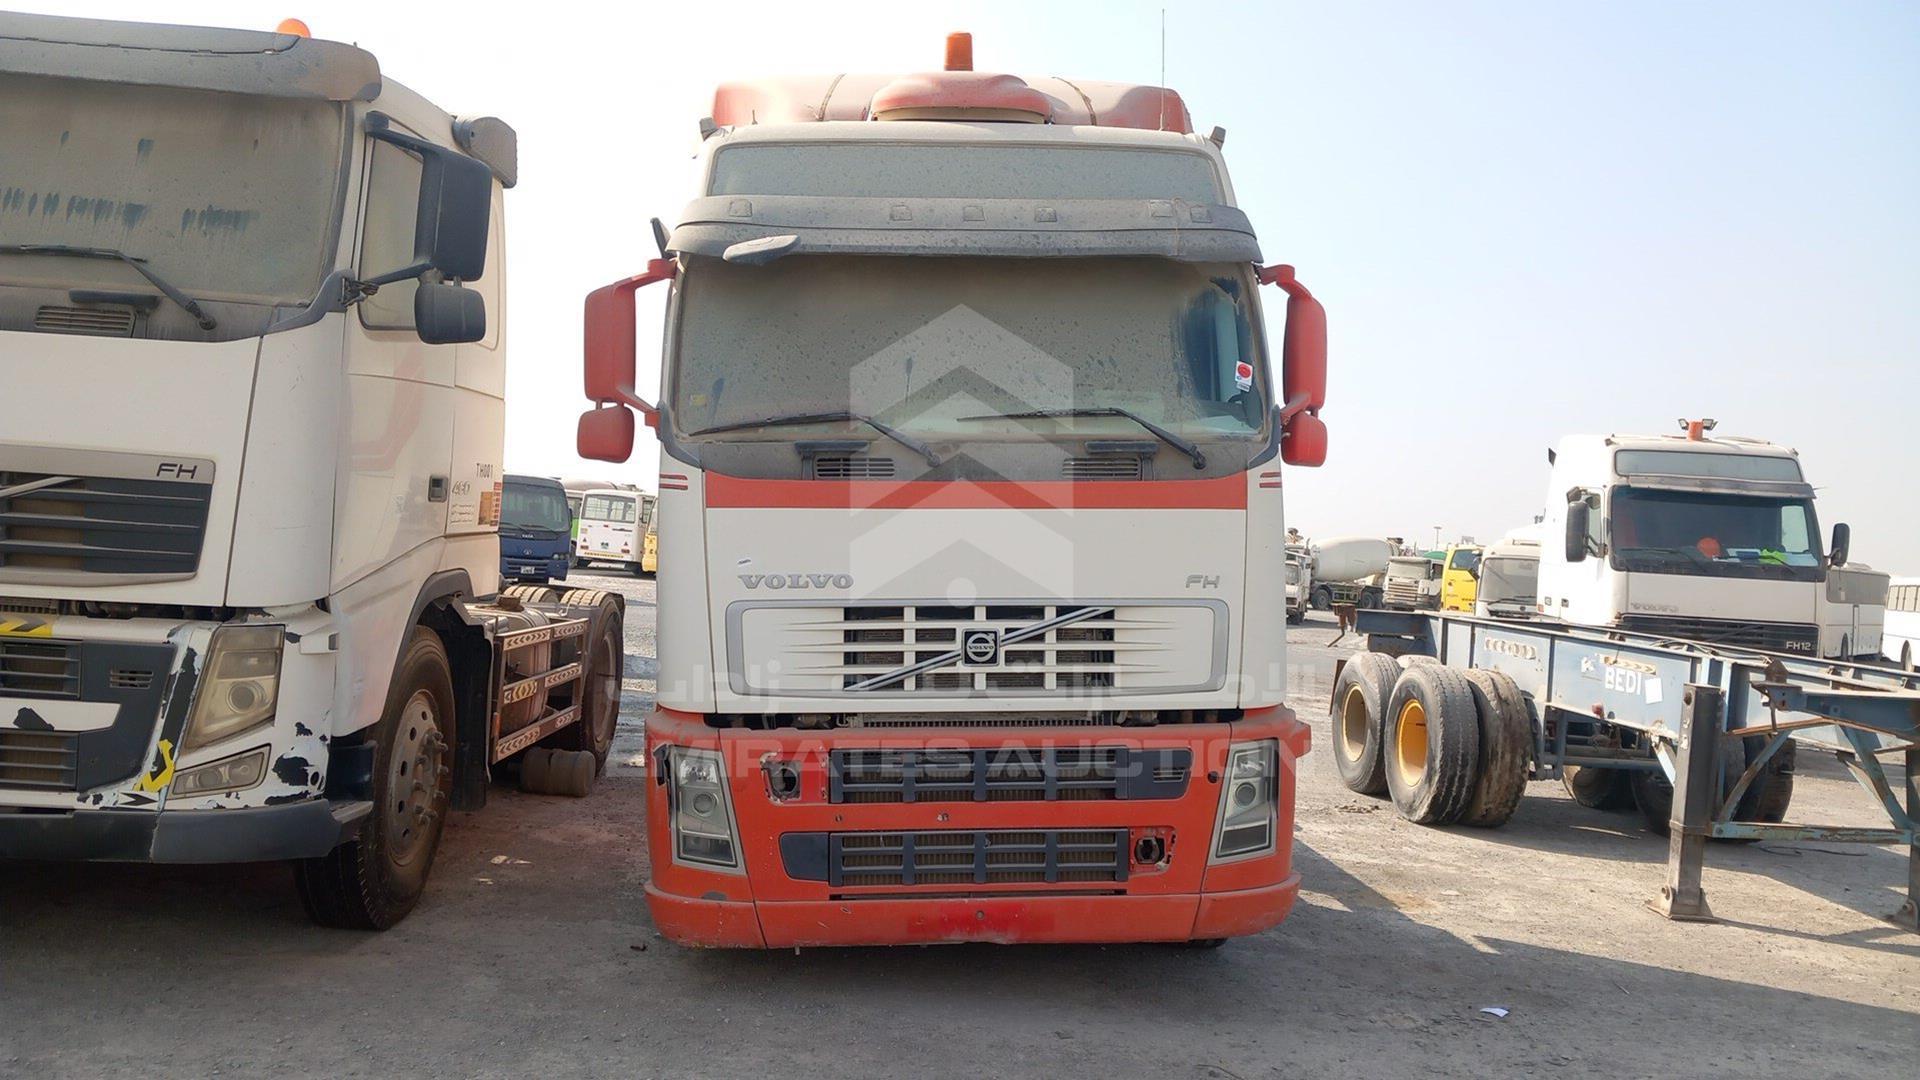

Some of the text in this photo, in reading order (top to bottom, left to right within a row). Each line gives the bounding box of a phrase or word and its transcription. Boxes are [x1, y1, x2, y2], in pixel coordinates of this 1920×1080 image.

[156, 463, 198, 480] FH
[737, 574, 854, 589] VOLVO
[1185, 574, 1220, 589] FH
[1785, 640, 1812, 651] FH12
[1604, 665, 1642, 695] BEDI
